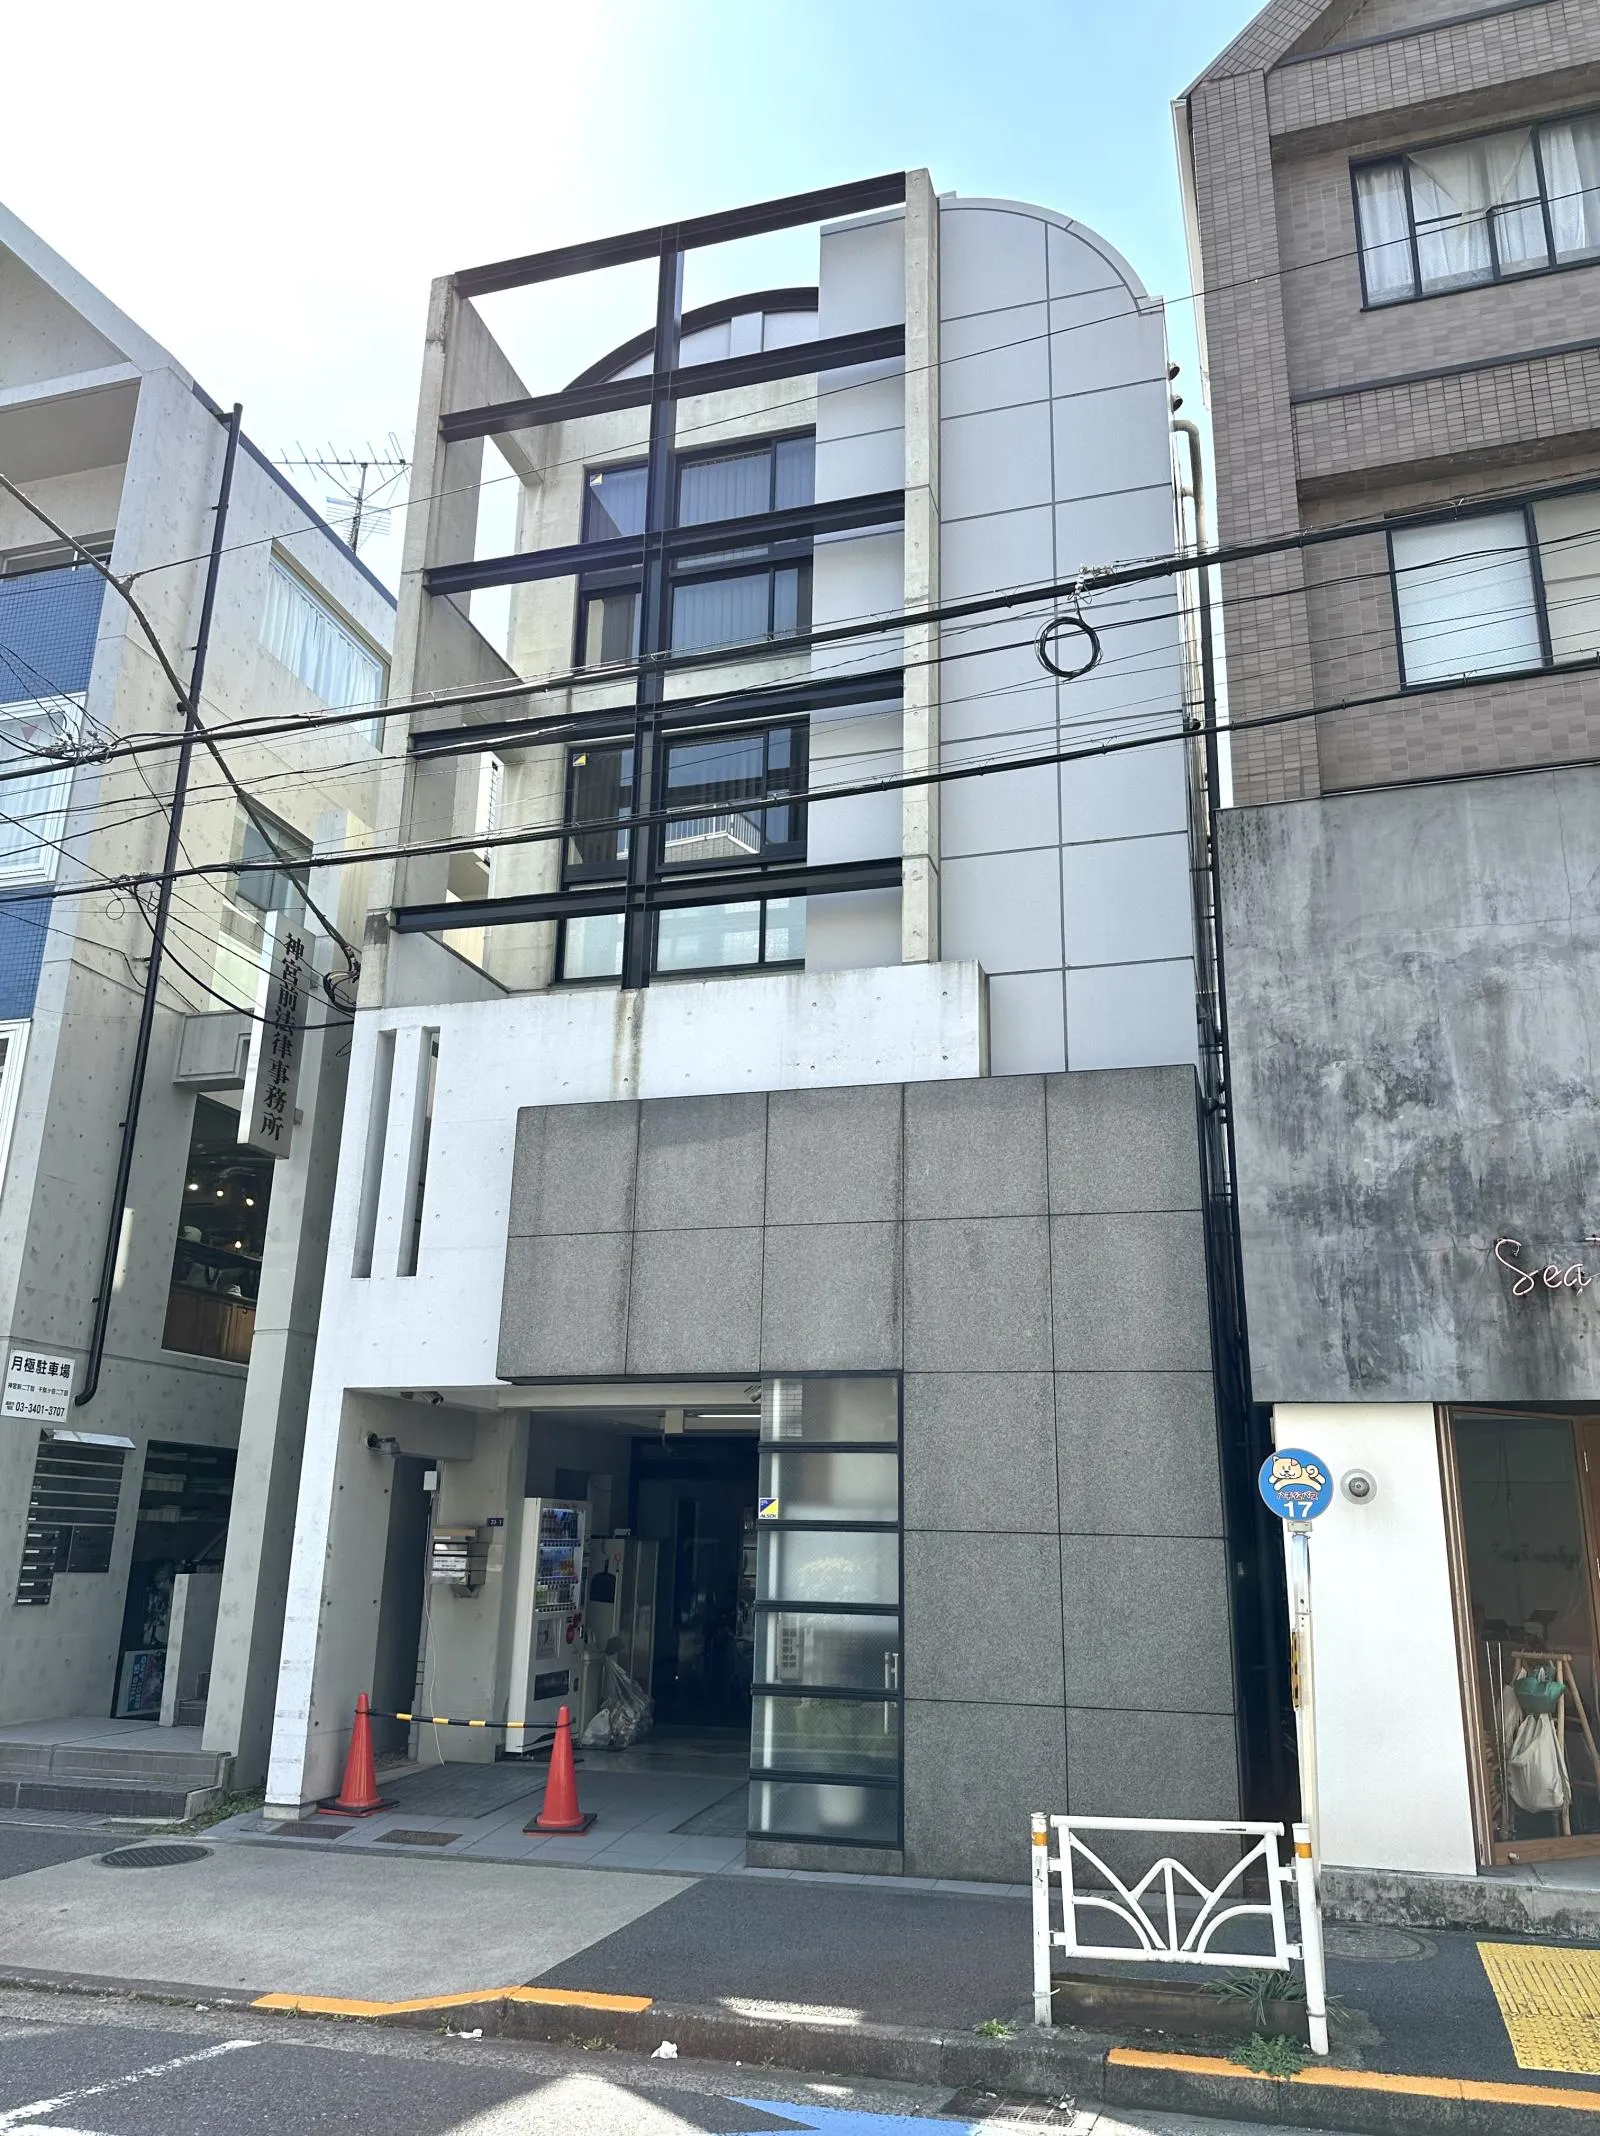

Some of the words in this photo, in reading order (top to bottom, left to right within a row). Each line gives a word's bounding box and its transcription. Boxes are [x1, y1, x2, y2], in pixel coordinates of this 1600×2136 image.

[260, 932, 305, 1142] 神宮前法律事務所
[1495, 1238, 1600, 1296] Sea
[11, 1356, 71, 1379] 月極駐車場
[15, 1401, 65, 1417] 03-3401-3707
[1283, 1501, 1313, 1518] 17
